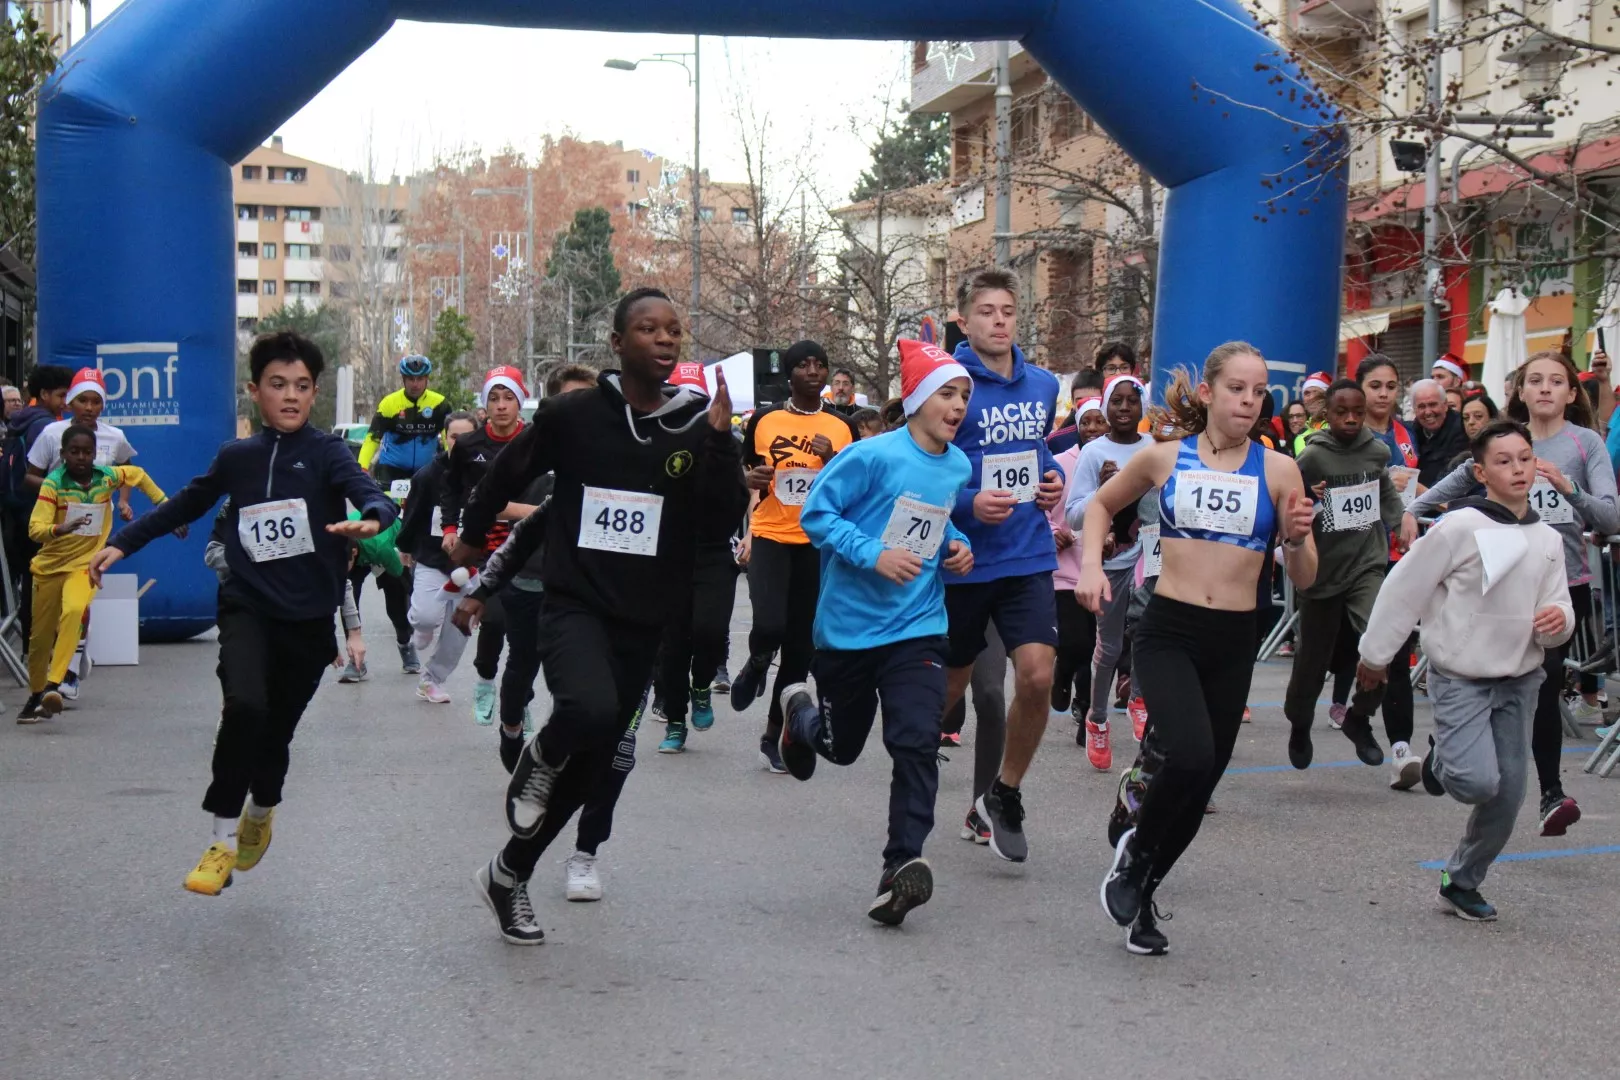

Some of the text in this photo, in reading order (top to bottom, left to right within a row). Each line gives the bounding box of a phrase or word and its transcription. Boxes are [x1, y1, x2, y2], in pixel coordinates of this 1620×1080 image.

[97, 355, 179, 400] bnf
[978, 420, 1046, 446] JONES
[992, 467, 1030, 489] 196
[1191, 486, 1242, 514] 155
[1341, 494, 1372, 515] 490
[250, 516, 295, 544] 136
[594, 506, 645, 535] 488
[906, 516, 931, 541] 70
